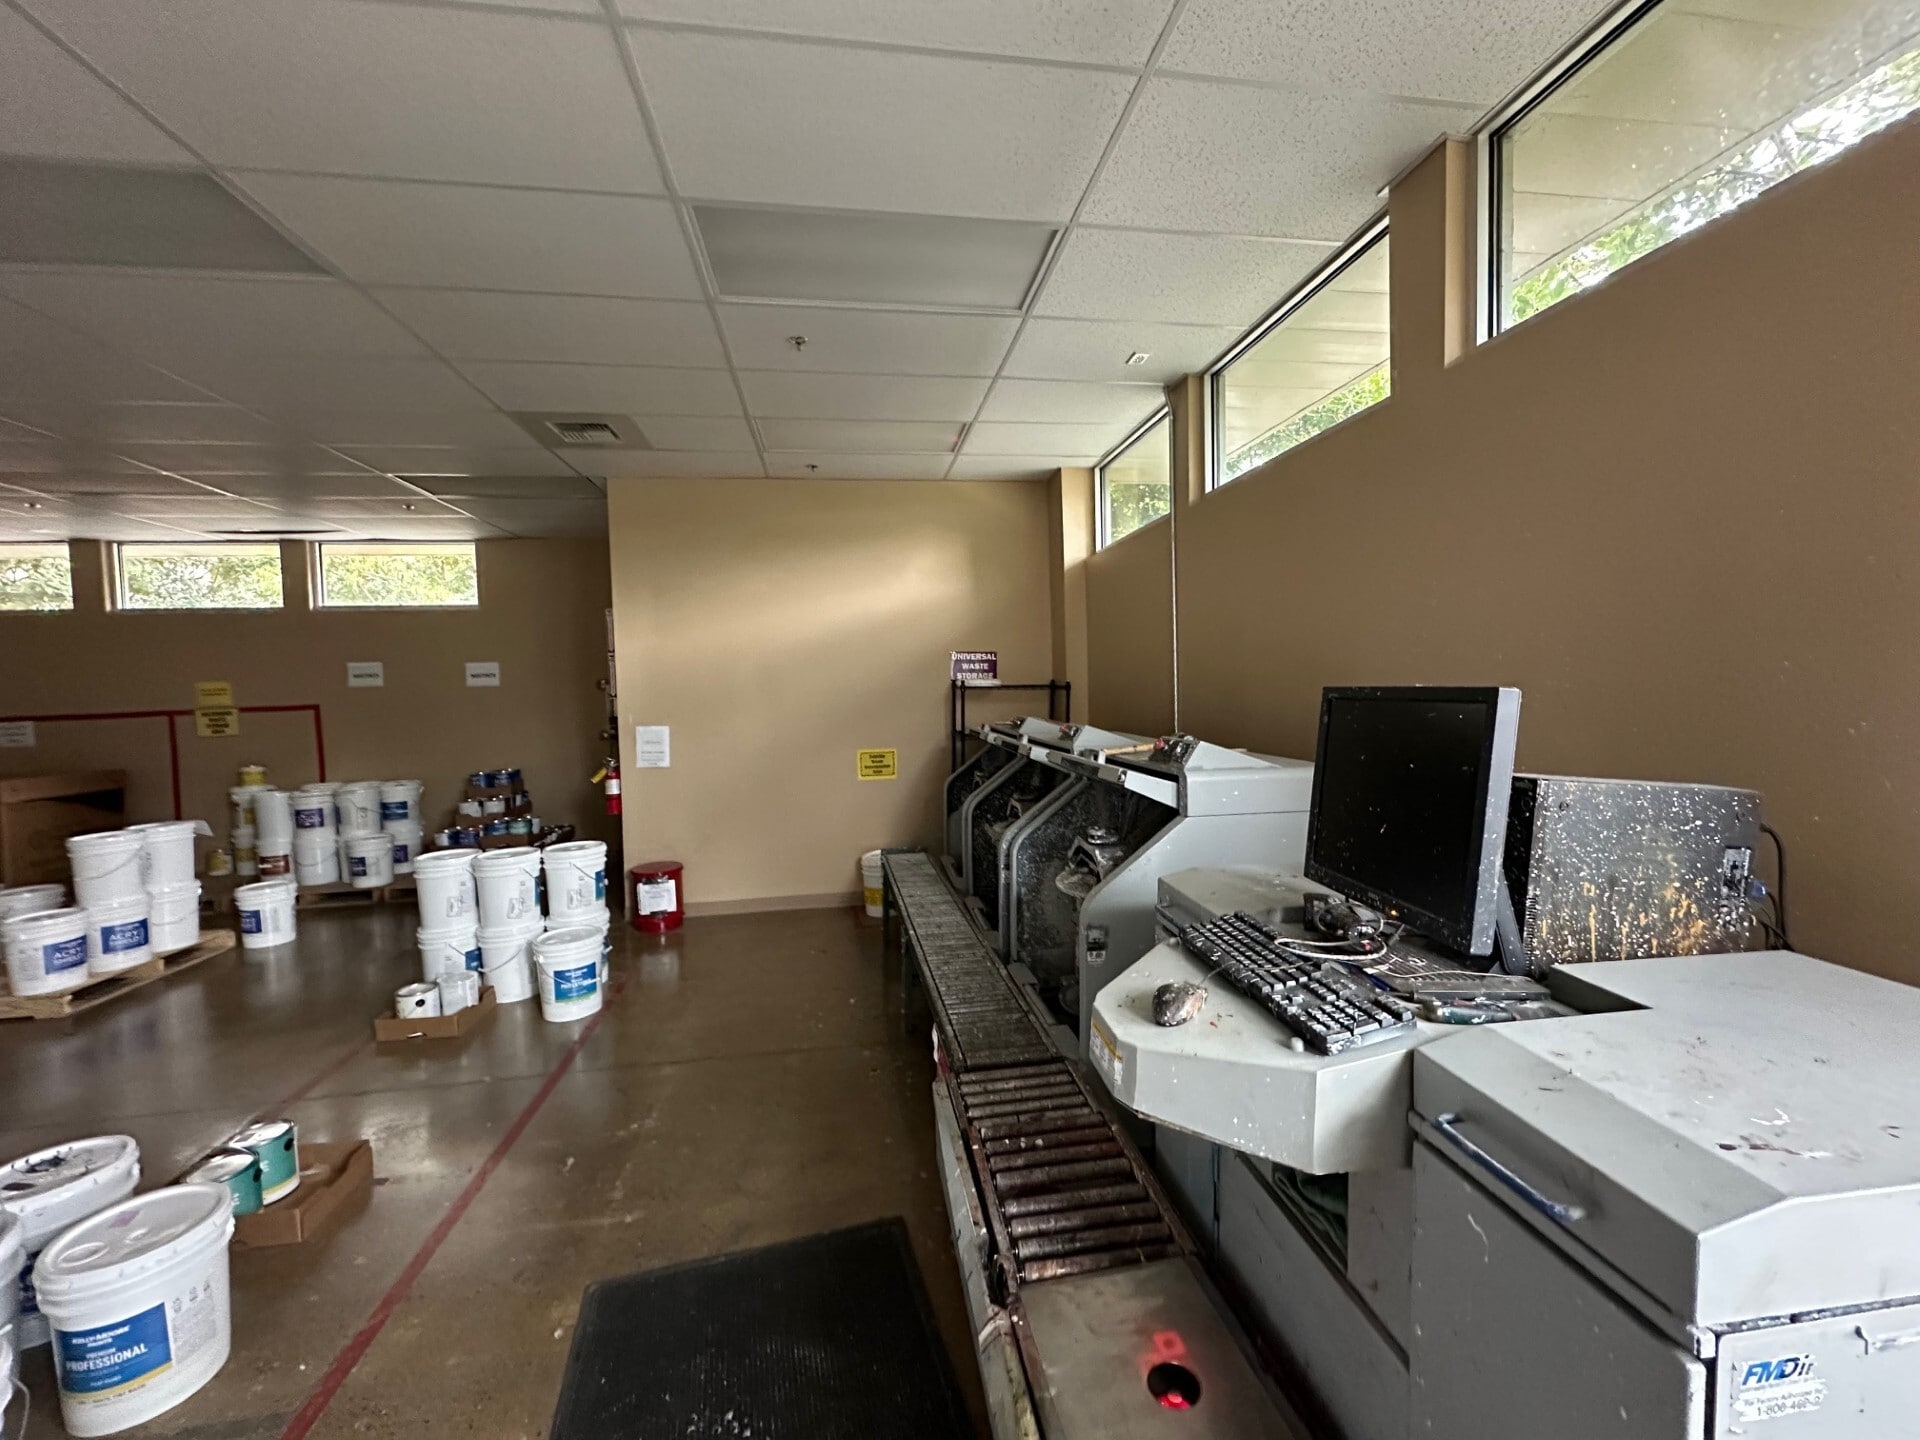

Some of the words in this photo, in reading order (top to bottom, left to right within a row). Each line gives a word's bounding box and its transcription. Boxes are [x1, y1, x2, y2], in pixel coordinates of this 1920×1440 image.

[951, 651, 997, 660] UNIVERSAL
[961, 662, 989, 670] WASTE
[956, 672, 994, 680] STORAGE
[66, 1342, 149, 1372] PROFESSIONAL
